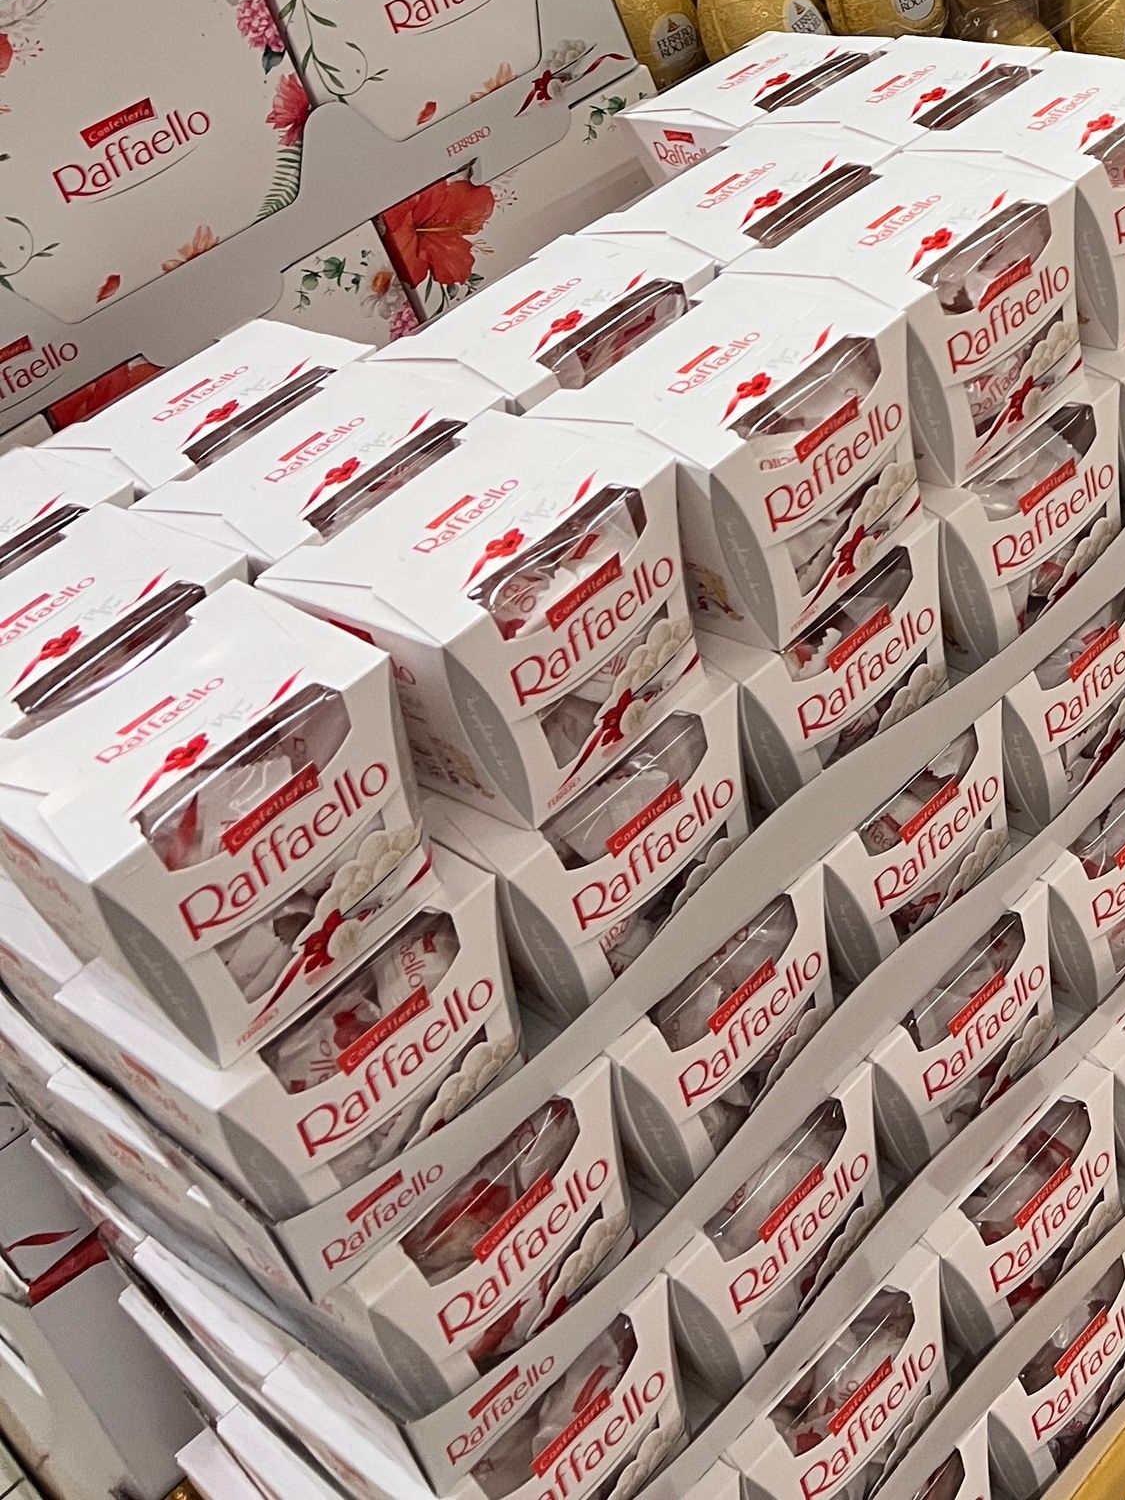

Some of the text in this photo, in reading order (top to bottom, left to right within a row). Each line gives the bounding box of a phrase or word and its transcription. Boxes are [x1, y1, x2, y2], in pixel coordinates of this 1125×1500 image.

[52, 109, 211, 204] Raffaello
[446, 125, 492, 157] FERRERO
[1027, 86, 1100, 131] Raffaello
[697, 162, 776, 209] Raffaello
[858, 194, 942, 248] Raffaello
[491, 277, 582, 334] Raffaello
[946, 263, 1070, 374] Raffaello
[0, 339, 79, 401] ffaello
[152, 365, 250, 423] Raffaello
[667, 331, 762, 396] Raffaello
[264, 416, 365, 484] Raffaello
[764, 402, 902, 532] Raffaello
[412, 478, 519, 554] Raffaello
[991, 462, 1114, 576] Raffaello
[0, 576, 95, 648] affaello
[510, 556, 674, 706] Raffaello
[94, 676, 225, 765] Raffaello
[796, 606, 935, 742] Raffaello
[178, 761, 389, 941] Raffaello
[570, 778, 734, 931] Raffaello
[873, 774, 999, 910] Raffaello
[297, 978, 495, 1159] Raffaello
[345, 996, 429, 1069] Confetteria
[678, 951, 822, 1108] Raffaello
[922, 963, 1045, 1101] Raffaello
[322, 1164, 444, 1271] Raffaello
[437, 1158, 610, 1345] Raffaello
[728, 1152, 868, 1314] Raffaello
[989, 1152, 1111, 1293] Raffaello
[447, 1354, 556, 1467] Raffaello
[533, 1369, 667, 1500] affaello
[799, 1342, 937, 1499] Raffaello
